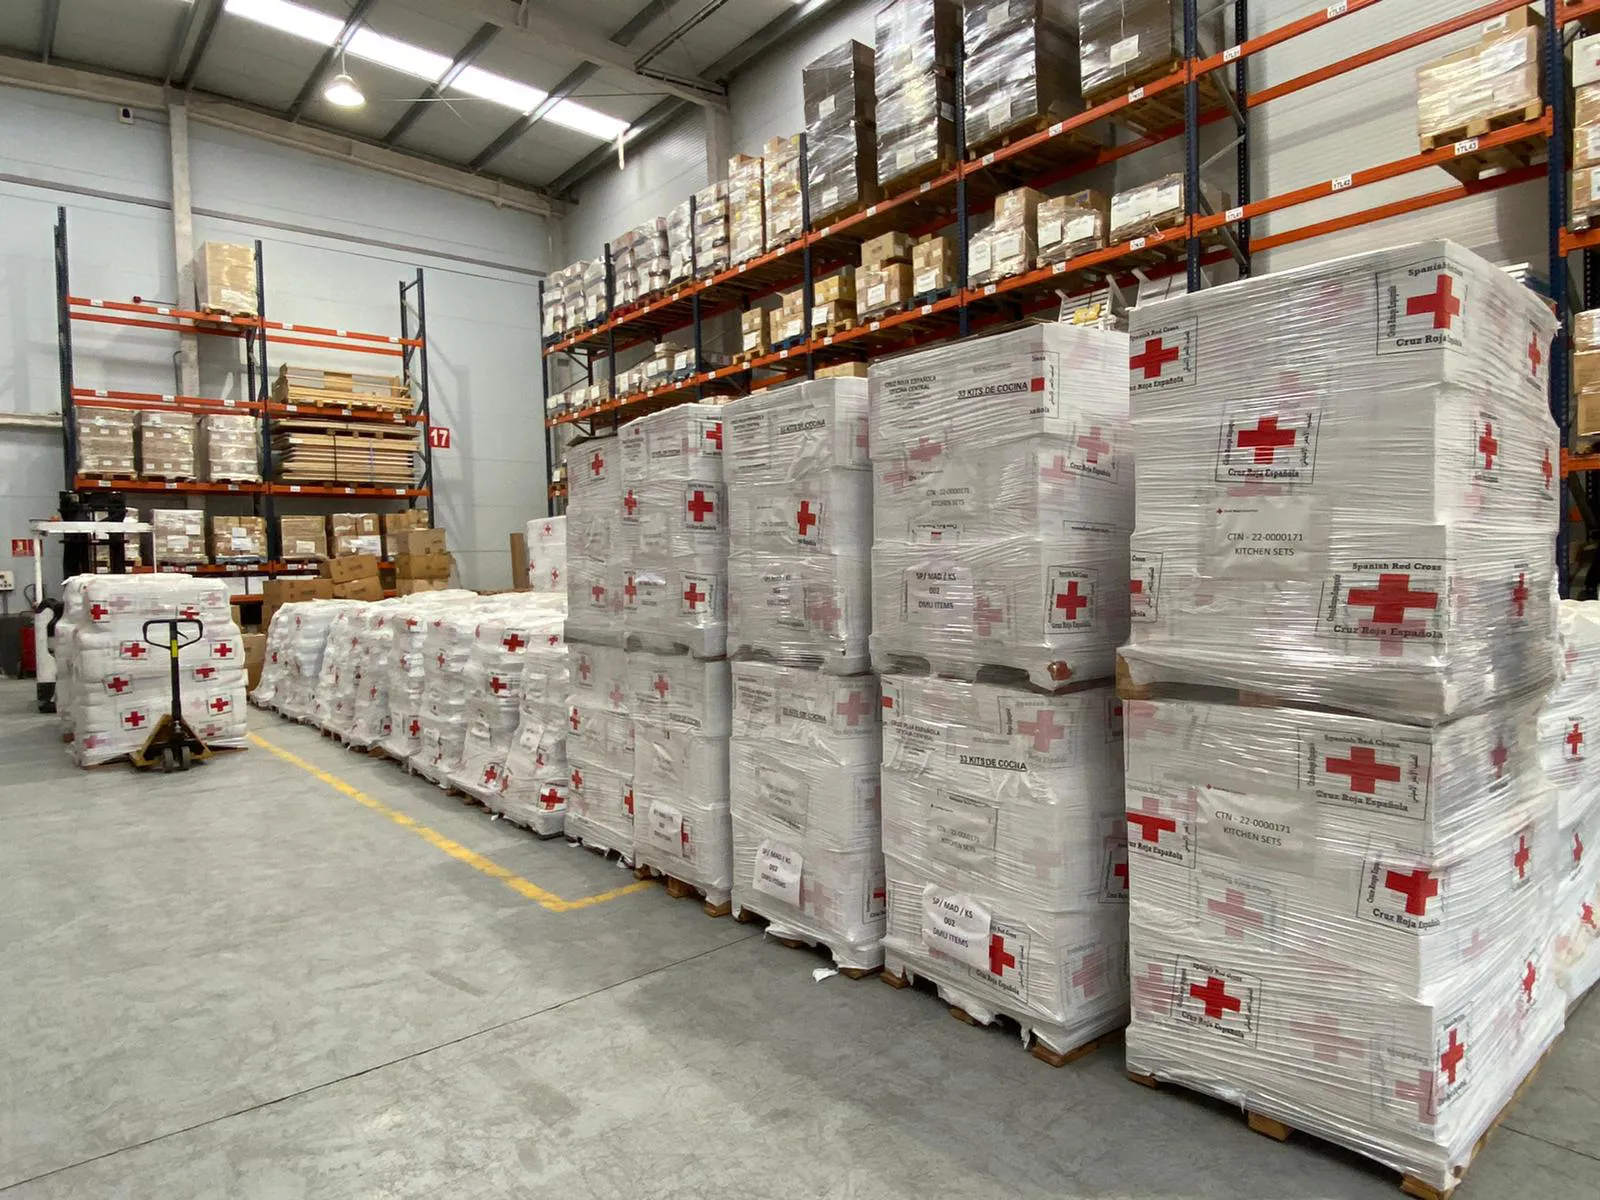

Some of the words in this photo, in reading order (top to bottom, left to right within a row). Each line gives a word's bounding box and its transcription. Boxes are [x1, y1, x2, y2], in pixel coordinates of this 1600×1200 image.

[1396, 336, 1422, 347] Cruz
[967, 386, 983, 398] KITS
[985, 385, 995, 395] DE
[998, 381, 1028, 394] COCINA
[431, 429, 448, 446] 17
[1265, 468, 1299, 479] Española
[1227, 533, 1244, 541] CTN
[1252, 533, 1303, 541] 22-0000171
[1235, 547, 1270, 555] KITCHEN
[1273, 547, 1294, 556] SETS
[1353, 562, 1388, 571] Spanish
[1392, 562, 1410, 570] Red
[1414, 562, 1441, 571] Cross
[1334, 625, 1359, 634] Cruz
[1361, 626, 1387, 636] Roja
[1391, 627, 1443, 639] Española
[960, 754, 967, 764] 33
[969, 755, 985, 765] KITS
[986, 757, 996, 767] DE
[1316, 789, 1339, 799] Cruz
[1342, 793, 1362, 804] Roja
[1366, 797, 1408, 811] Española
[1215, 811, 1232, 821] CTN
[1240, 815, 1291, 833] 22-0000171
[1224, 827, 1259, 841] KITCHEN
[1261, 835, 1282, 846] SETS
[1138, 842, 1152, 853] Roja
[1153, 846, 1183, 860] Española
[944, 901, 959, 913] MAD
[965, 909, 973, 918] KS
[943, 917, 956, 927] 002
[1373, 908, 1394, 920] Cruz
[1396, 915, 1416, 928] Roja
[949, 934, 968, 948] ITEMS
